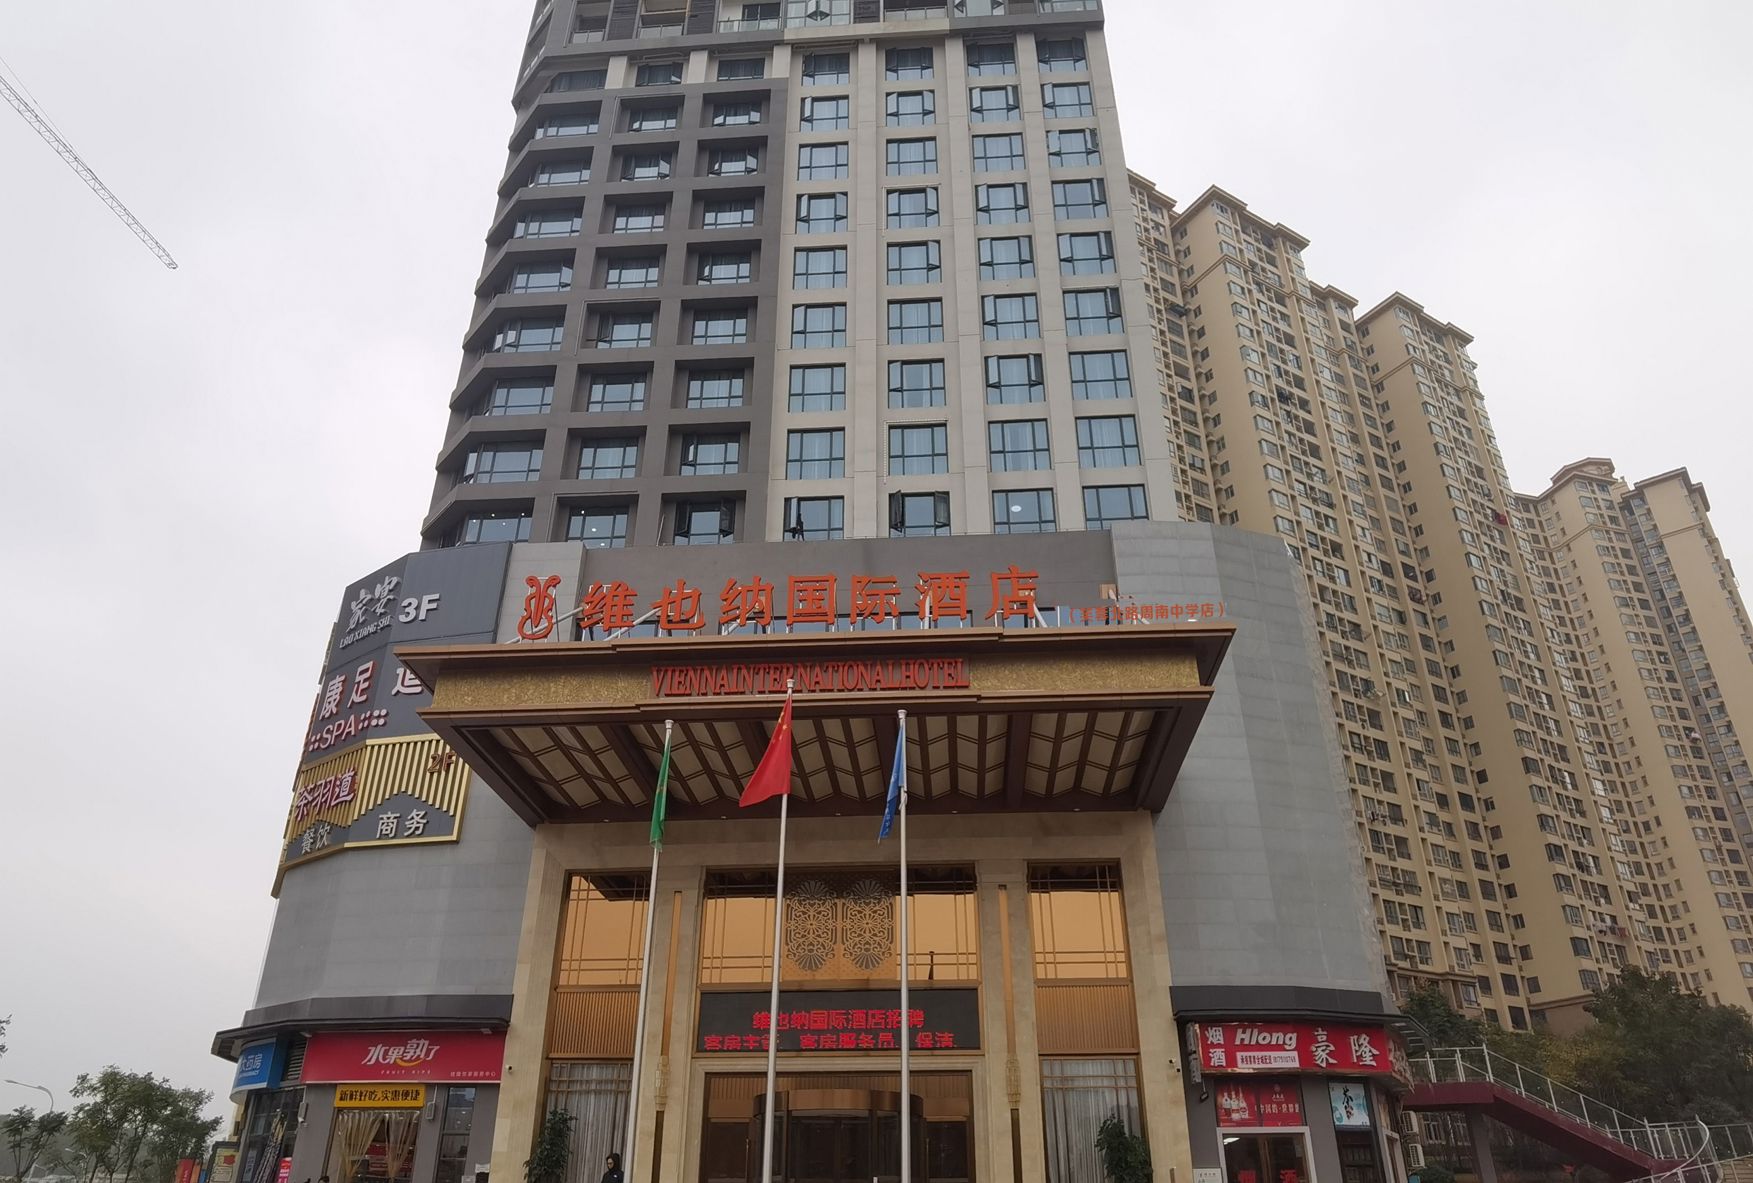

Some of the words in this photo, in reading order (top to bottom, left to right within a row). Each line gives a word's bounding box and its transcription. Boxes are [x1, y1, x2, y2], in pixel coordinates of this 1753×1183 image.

[398, 593, 440, 624] 3F
[580, 564, 1039, 631] 维也纳国际酒店
[320, 714, 356, 749] SPA
[427, 751, 457, 774] 2F
[301, 823, 332, 854] 餐饮
[376, 808, 429, 839] 商务
[752, 1010, 925, 1030] 维也纳国际酒店招聘
[362, 1038, 440, 1065] 水果熟了
[1205, 1027, 1226, 1067] 烟酒
[1310, 1027, 1380, 1068] 豪隆
